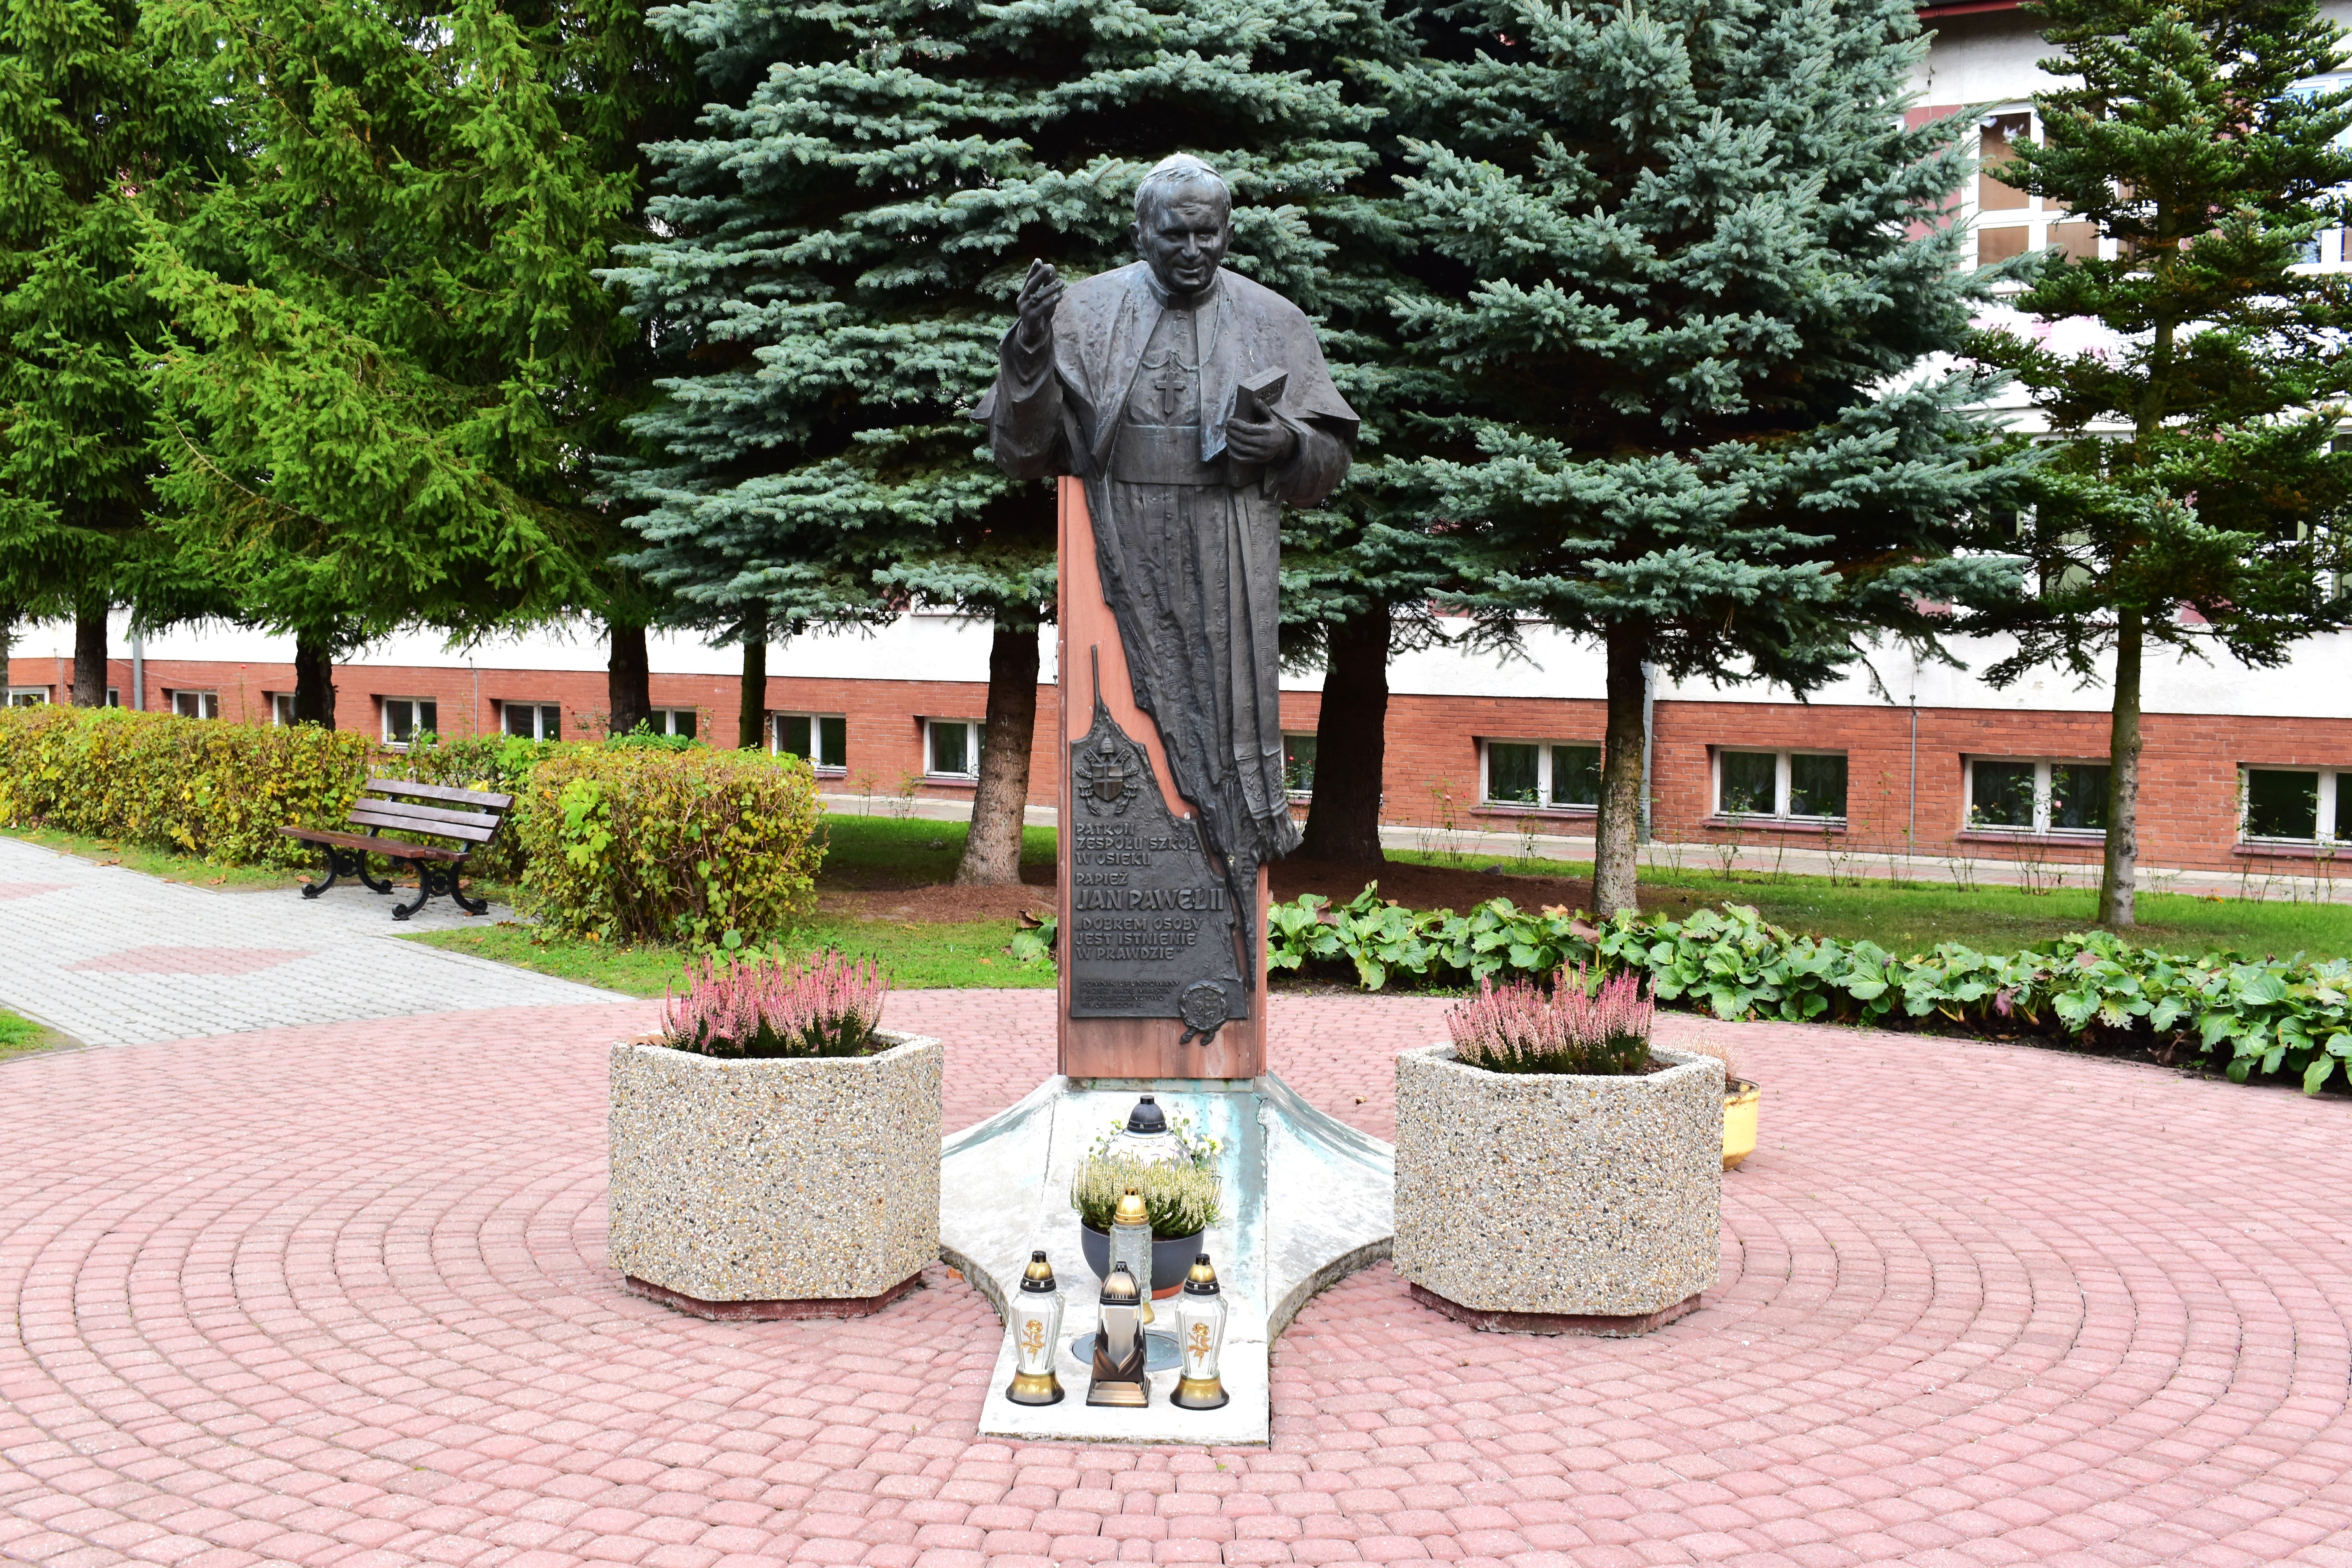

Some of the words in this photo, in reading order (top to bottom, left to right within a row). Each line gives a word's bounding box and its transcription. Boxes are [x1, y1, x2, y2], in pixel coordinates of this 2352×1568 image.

[1076, 823, 1135, 835] PATRON
[1076, 837, 1143, 850] ZESPOŁU
[1149, 835, 1197, 850] SZKÓŁ
[1076, 852, 1091, 865] W
[1096, 852, 1152, 866] OSIEKU
[1076, 870, 1129, 886] PAPIEŻ
[1076, 889, 1123, 910] JAN
[1129, 889, 1207, 910] PAWEŁ
[1210, 889, 1224, 910] II
[1153, 917, 1202, 931] OSOBY
[1076, 933, 1112, 946] JEST
[1118, 933, 1196, 946] ISTNIENIE
[1076, 947, 1091, 960] W
